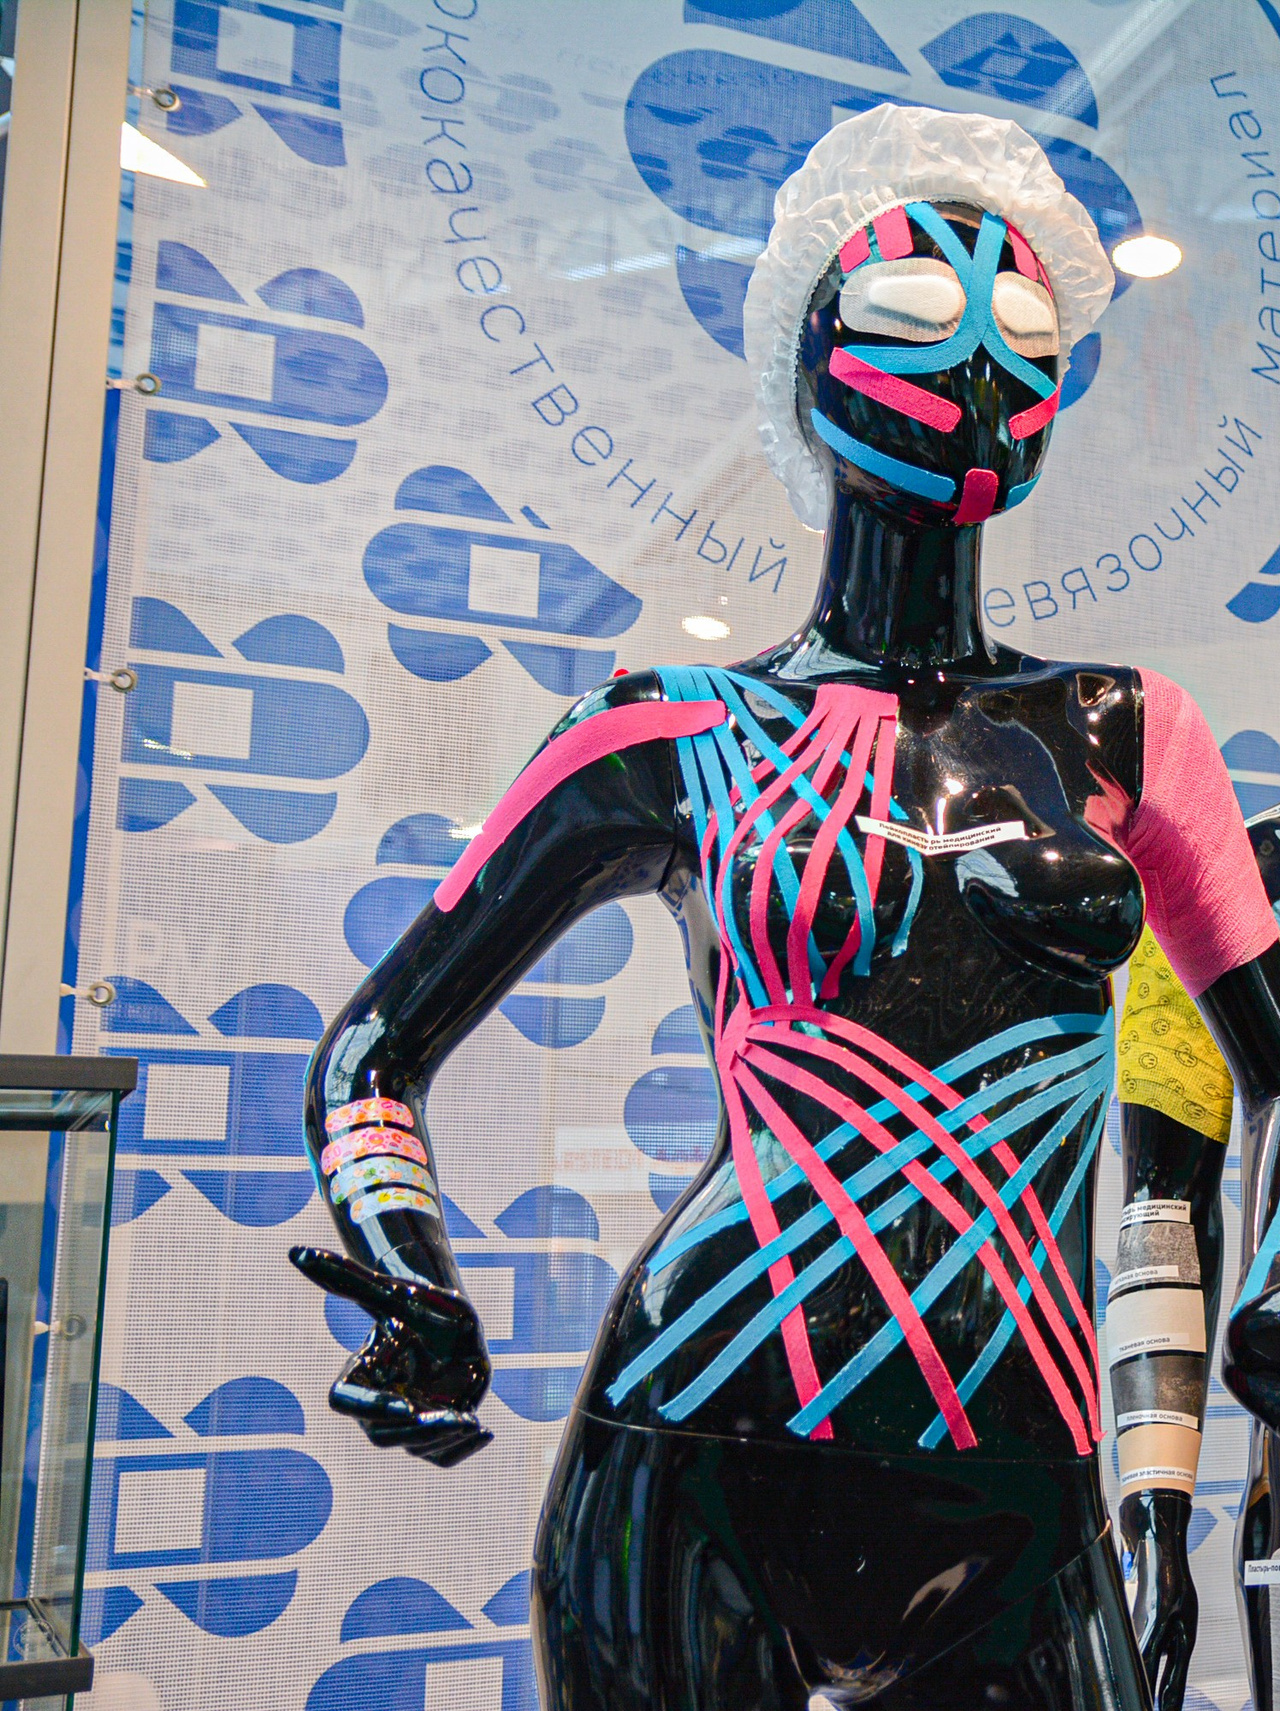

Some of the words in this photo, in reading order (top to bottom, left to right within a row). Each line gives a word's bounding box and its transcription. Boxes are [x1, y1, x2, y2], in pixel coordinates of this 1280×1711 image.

[983, 415, 1263, 627] евязочный
[943, 827, 1001, 843] медицинский
[1137, 1203, 1187, 1211] медицинский
[1146, 1337, 1171, 1345] основа
[1159, 1413, 1183, 1422] основа
